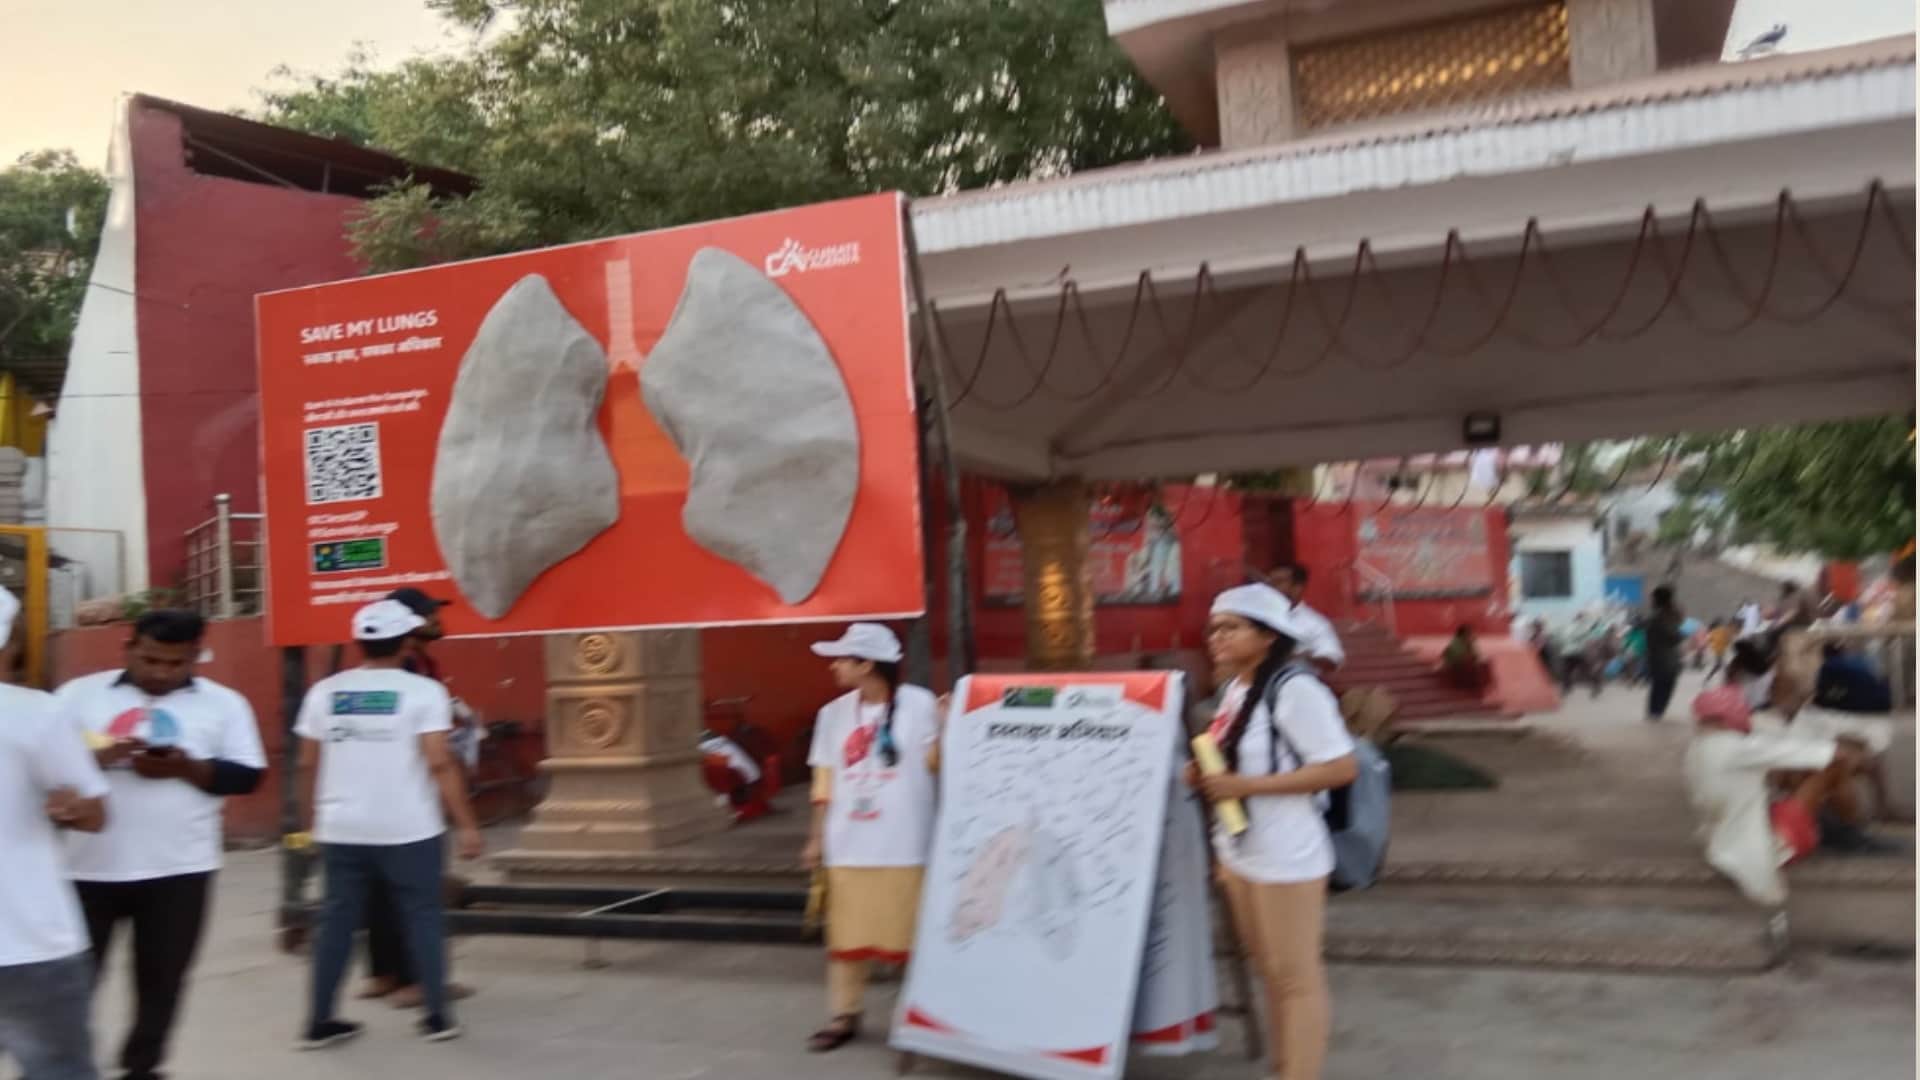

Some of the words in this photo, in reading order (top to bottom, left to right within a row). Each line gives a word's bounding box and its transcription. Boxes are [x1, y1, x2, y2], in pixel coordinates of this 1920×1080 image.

[300, 323, 345, 344] SAVE
[346, 318, 375, 338] MY
[376, 309, 439, 333] LUNGS
